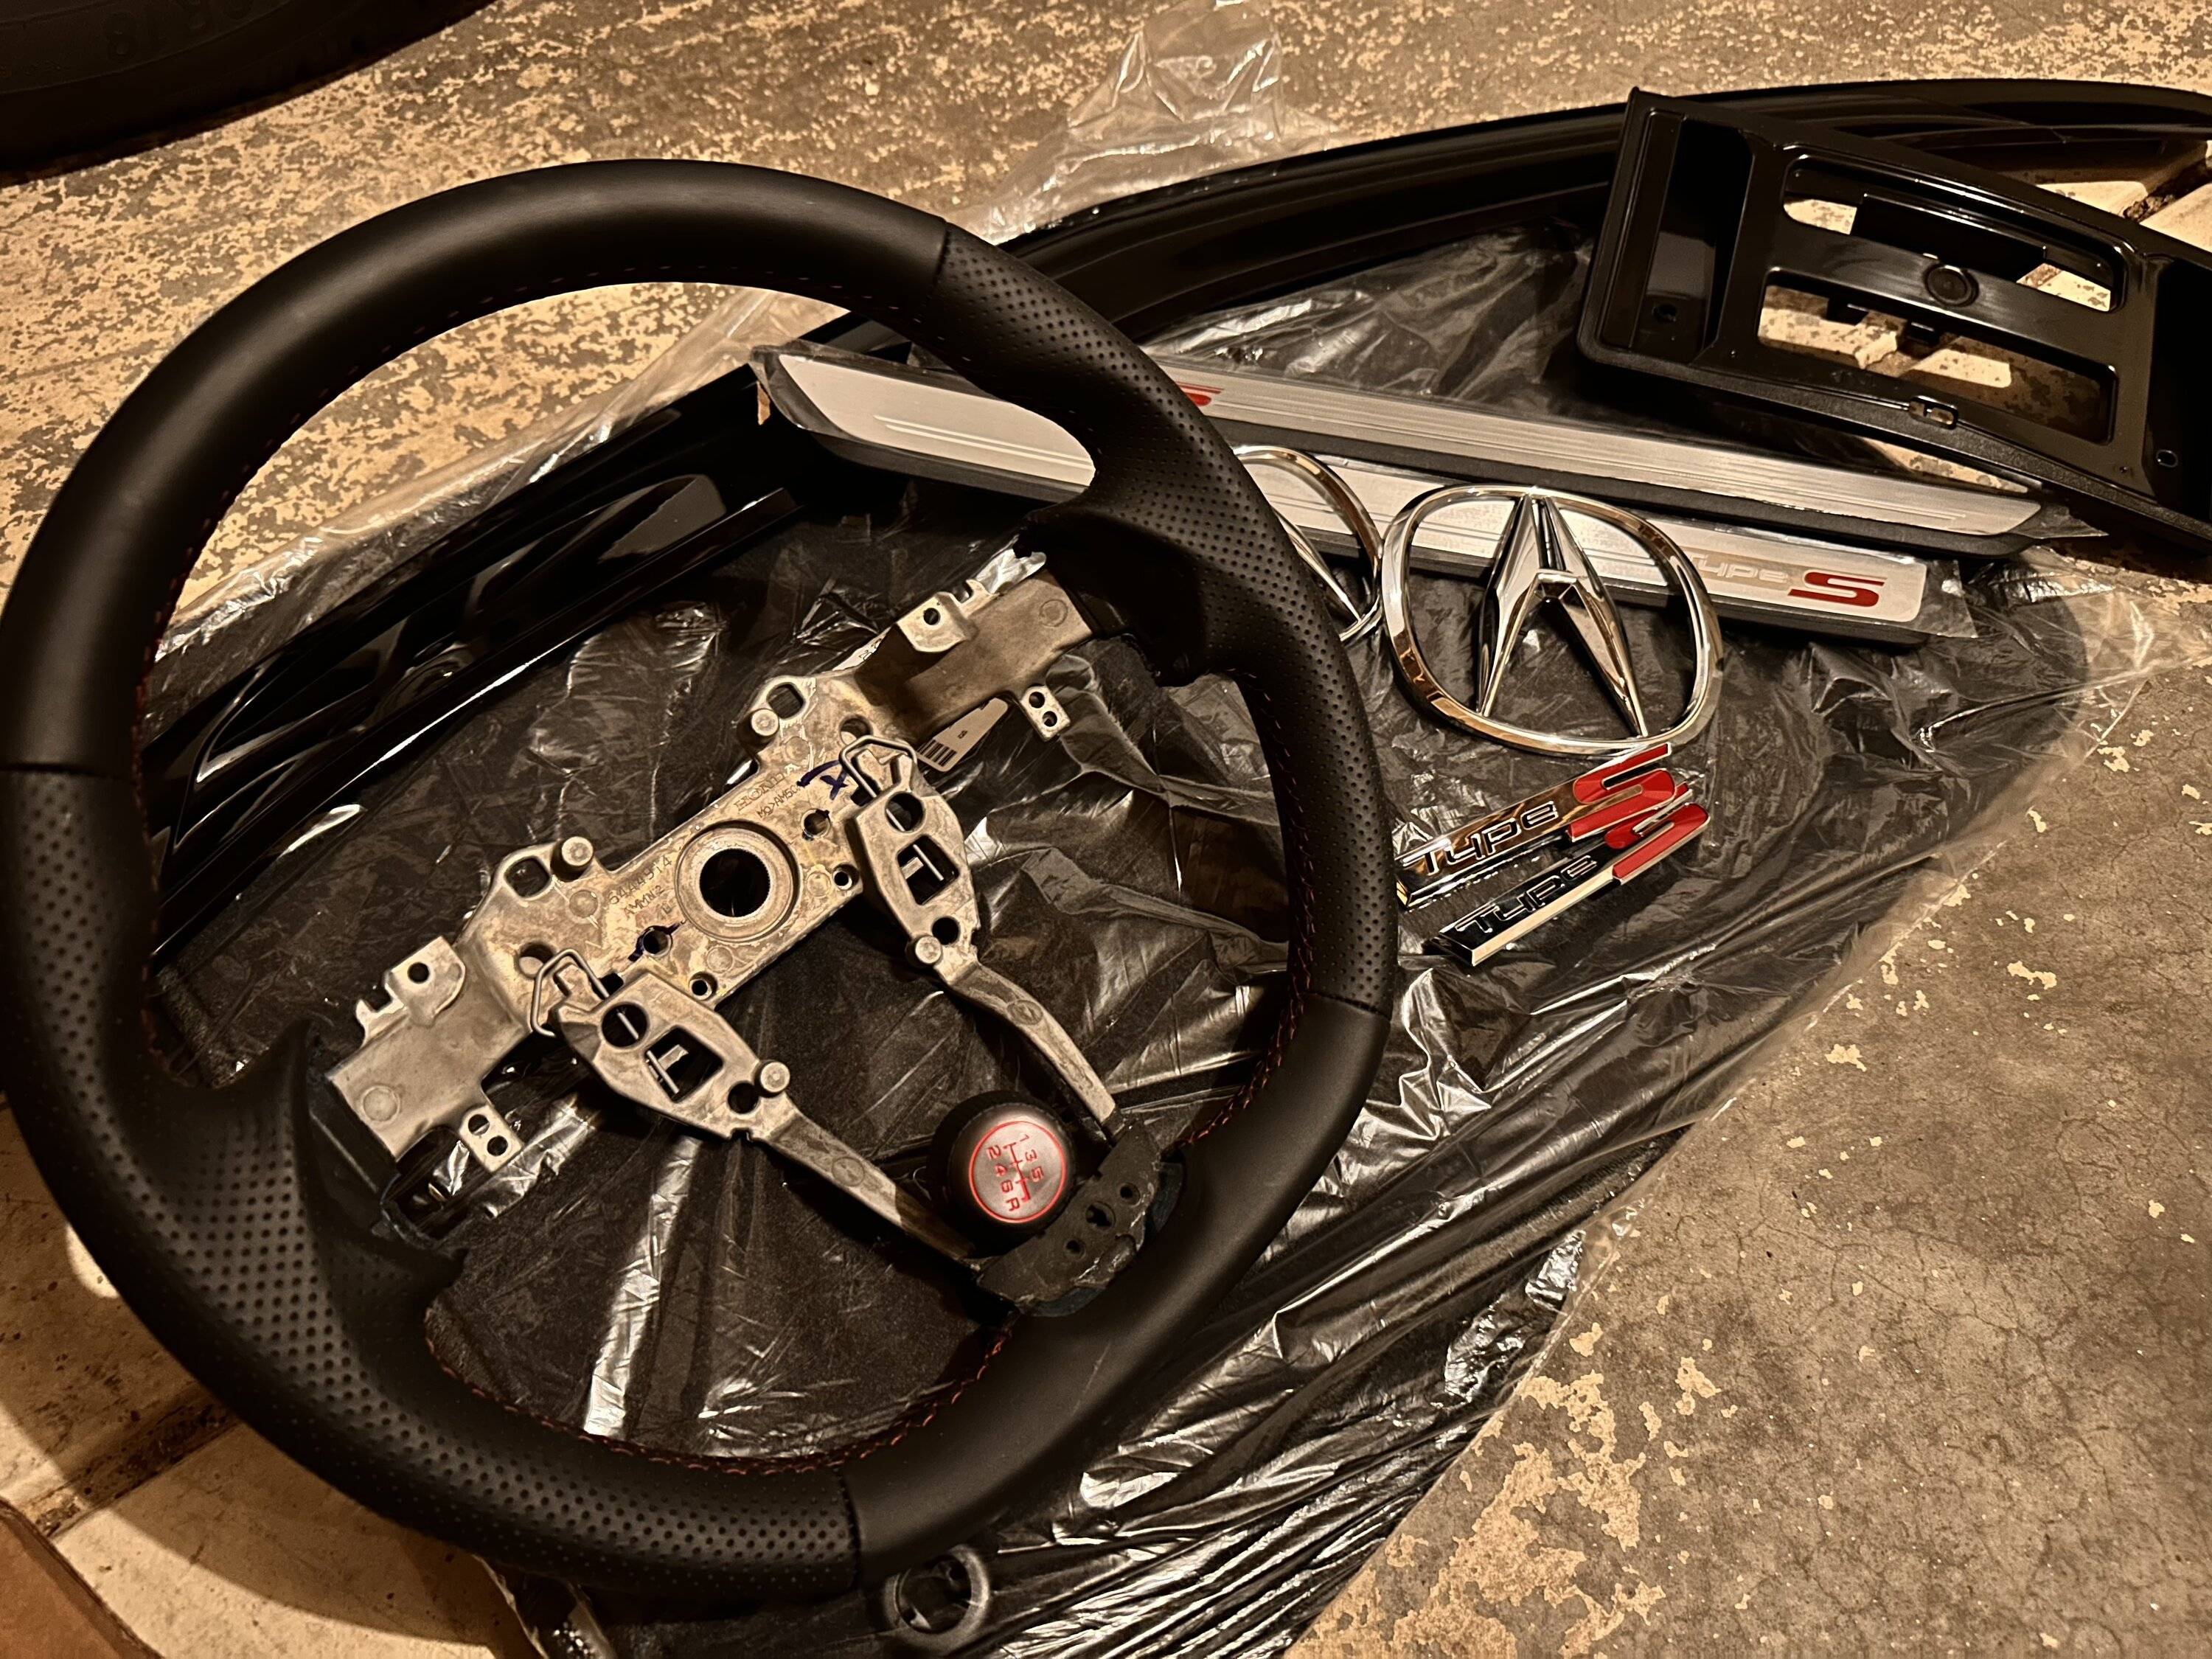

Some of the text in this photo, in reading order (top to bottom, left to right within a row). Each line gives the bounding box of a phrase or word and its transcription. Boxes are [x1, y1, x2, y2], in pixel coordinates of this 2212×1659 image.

[1787, 570, 1885, 608] S
[1566, 742, 1672, 842] S
[1604, 782, 1710, 885] S
[987, 1144, 1001, 1161] 2
[995, 1164, 1007, 1178] 4
[1006, 1197, 1020, 1211] R
[1024, 1149, 1037, 1163] 3
